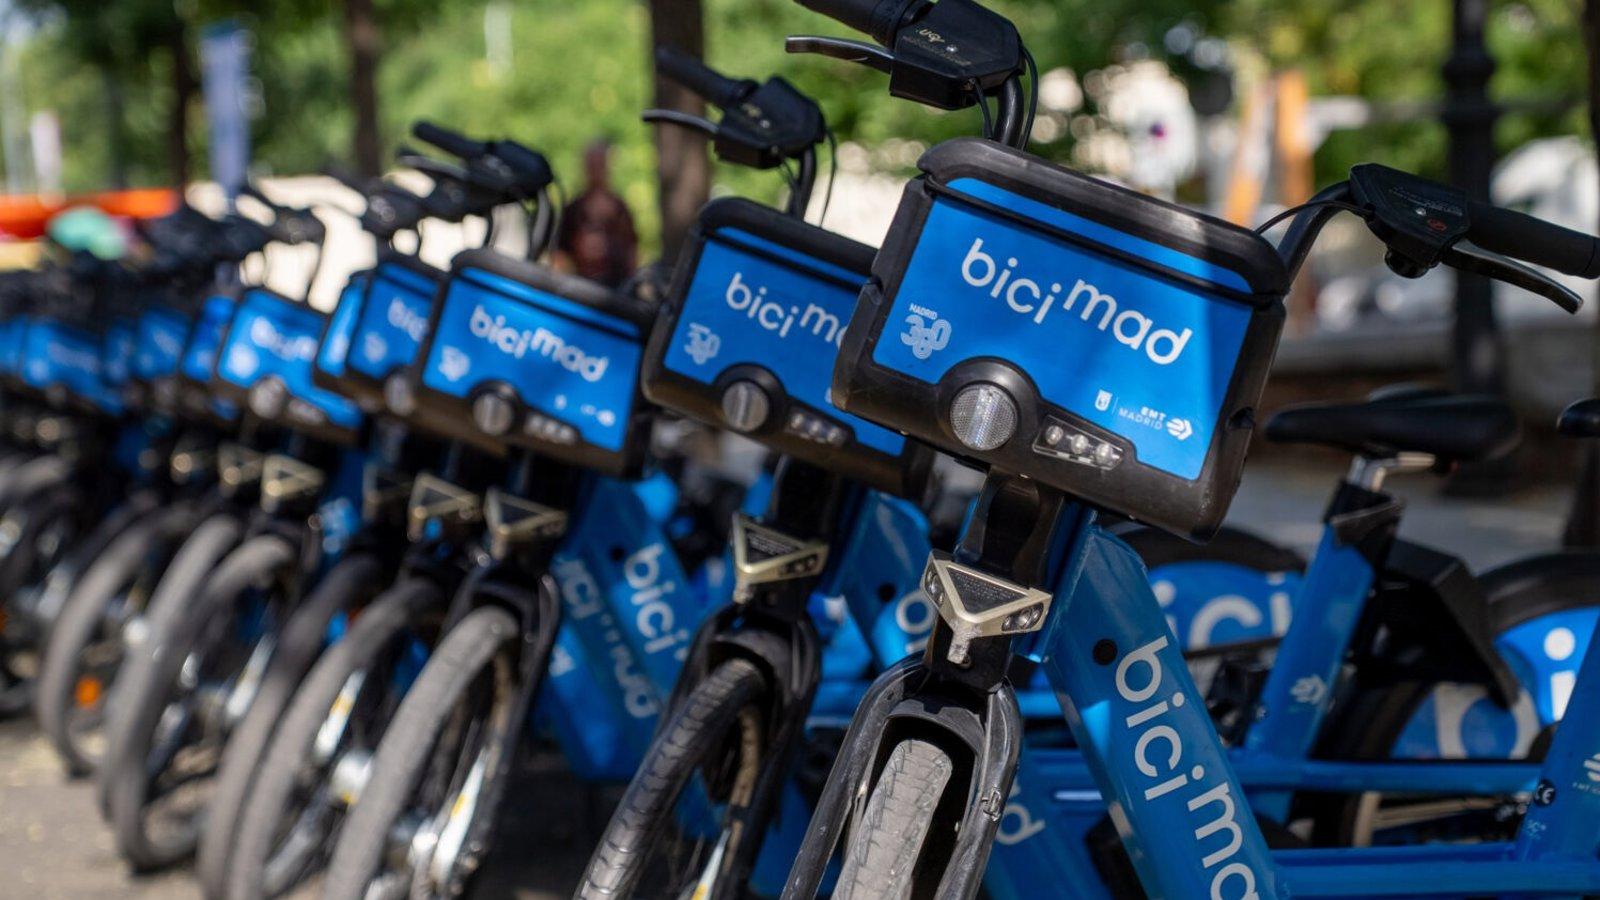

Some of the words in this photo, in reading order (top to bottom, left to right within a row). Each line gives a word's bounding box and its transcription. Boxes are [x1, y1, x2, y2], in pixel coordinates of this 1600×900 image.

[909, 303, 938, 320] MADRID
[1118, 407, 1162, 430] MADRID
[1140, 406, 1166, 421] EMT
